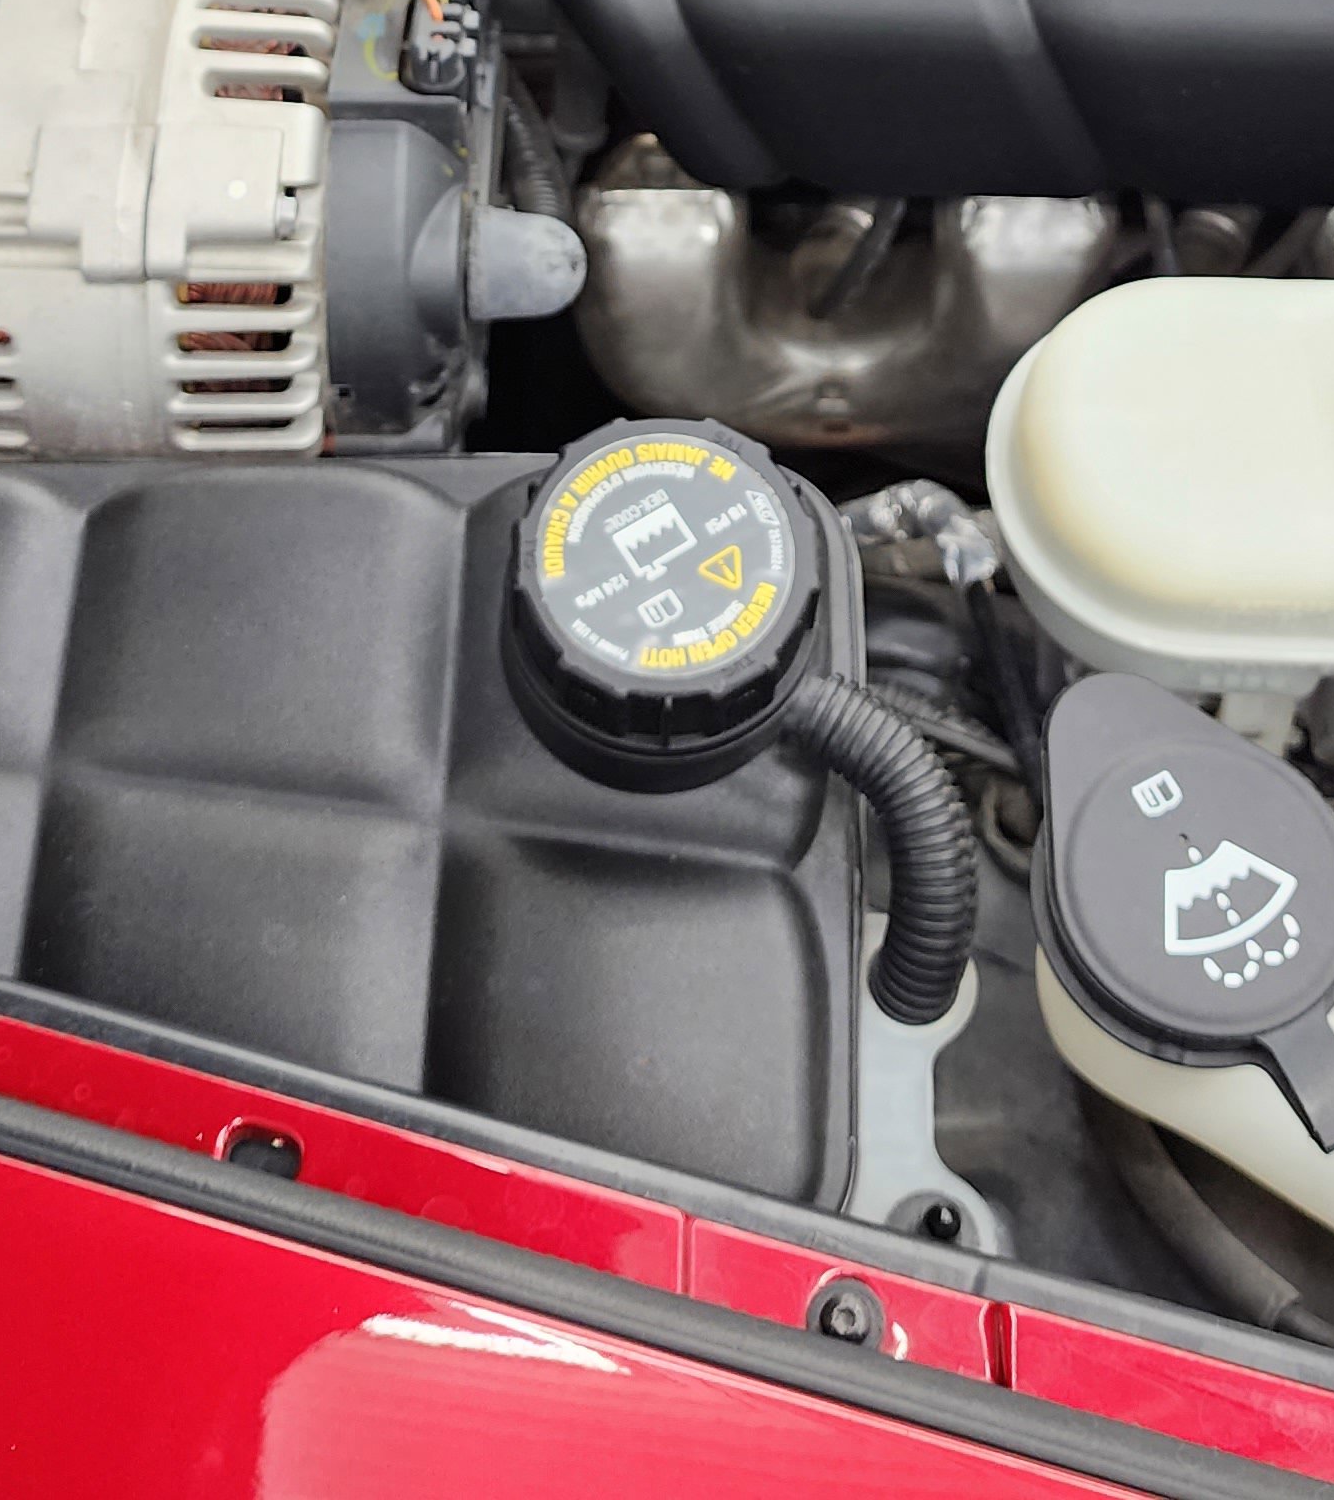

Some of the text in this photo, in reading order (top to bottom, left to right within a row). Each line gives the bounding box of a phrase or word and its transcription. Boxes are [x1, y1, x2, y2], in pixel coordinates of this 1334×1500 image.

[635, 442, 710, 467] JAMAIS
[708, 455, 738, 482] NE
[569, 448, 635, 496] OUVRIR
[704, 502, 748, 535] 18 PSI
[543, 508, 572, 580] CHAUD!
[601, 572, 630, 596] 124
[640, 581, 778, 669] NEVER OPEN HOT!
